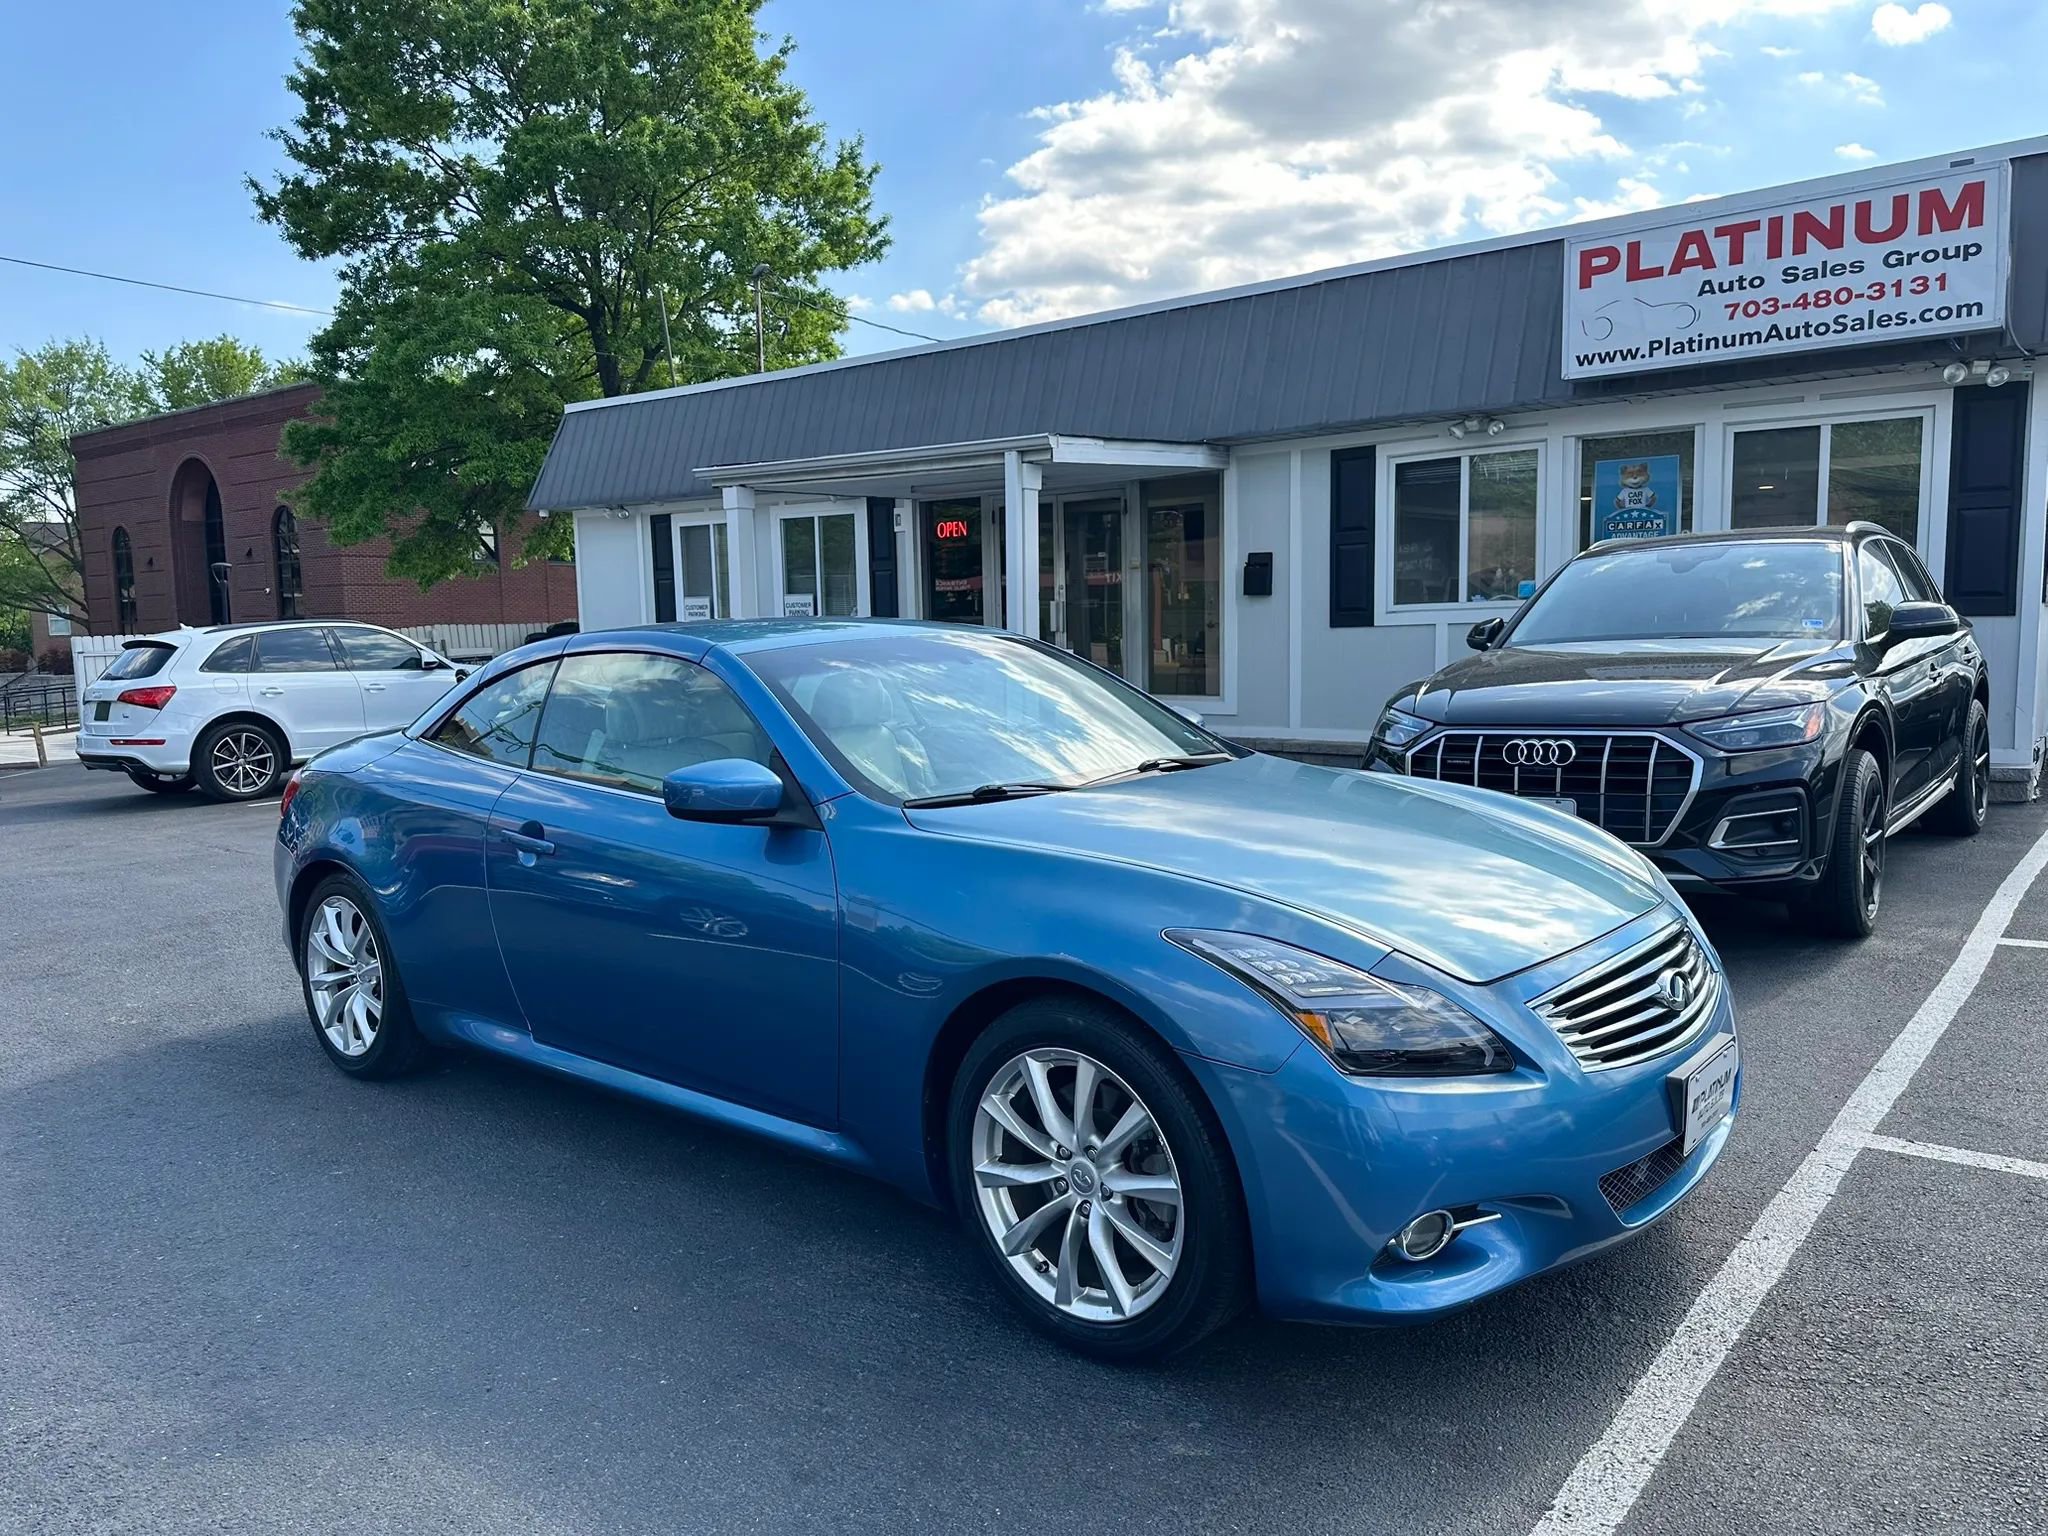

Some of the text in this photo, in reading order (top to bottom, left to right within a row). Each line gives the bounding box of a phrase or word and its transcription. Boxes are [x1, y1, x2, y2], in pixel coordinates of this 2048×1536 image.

[1579, 180, 1985, 290] PLATINUM
[1698, 240, 1983, 298] Auto Sales Group
[1724, 272, 1948, 321] 703-480-3131
[1575, 301, 1984, 368] www.PlatinumAutoSales.com
[937, 521, 967, 538] OPEN
[1608, 520, 1662, 531] CARFAX
